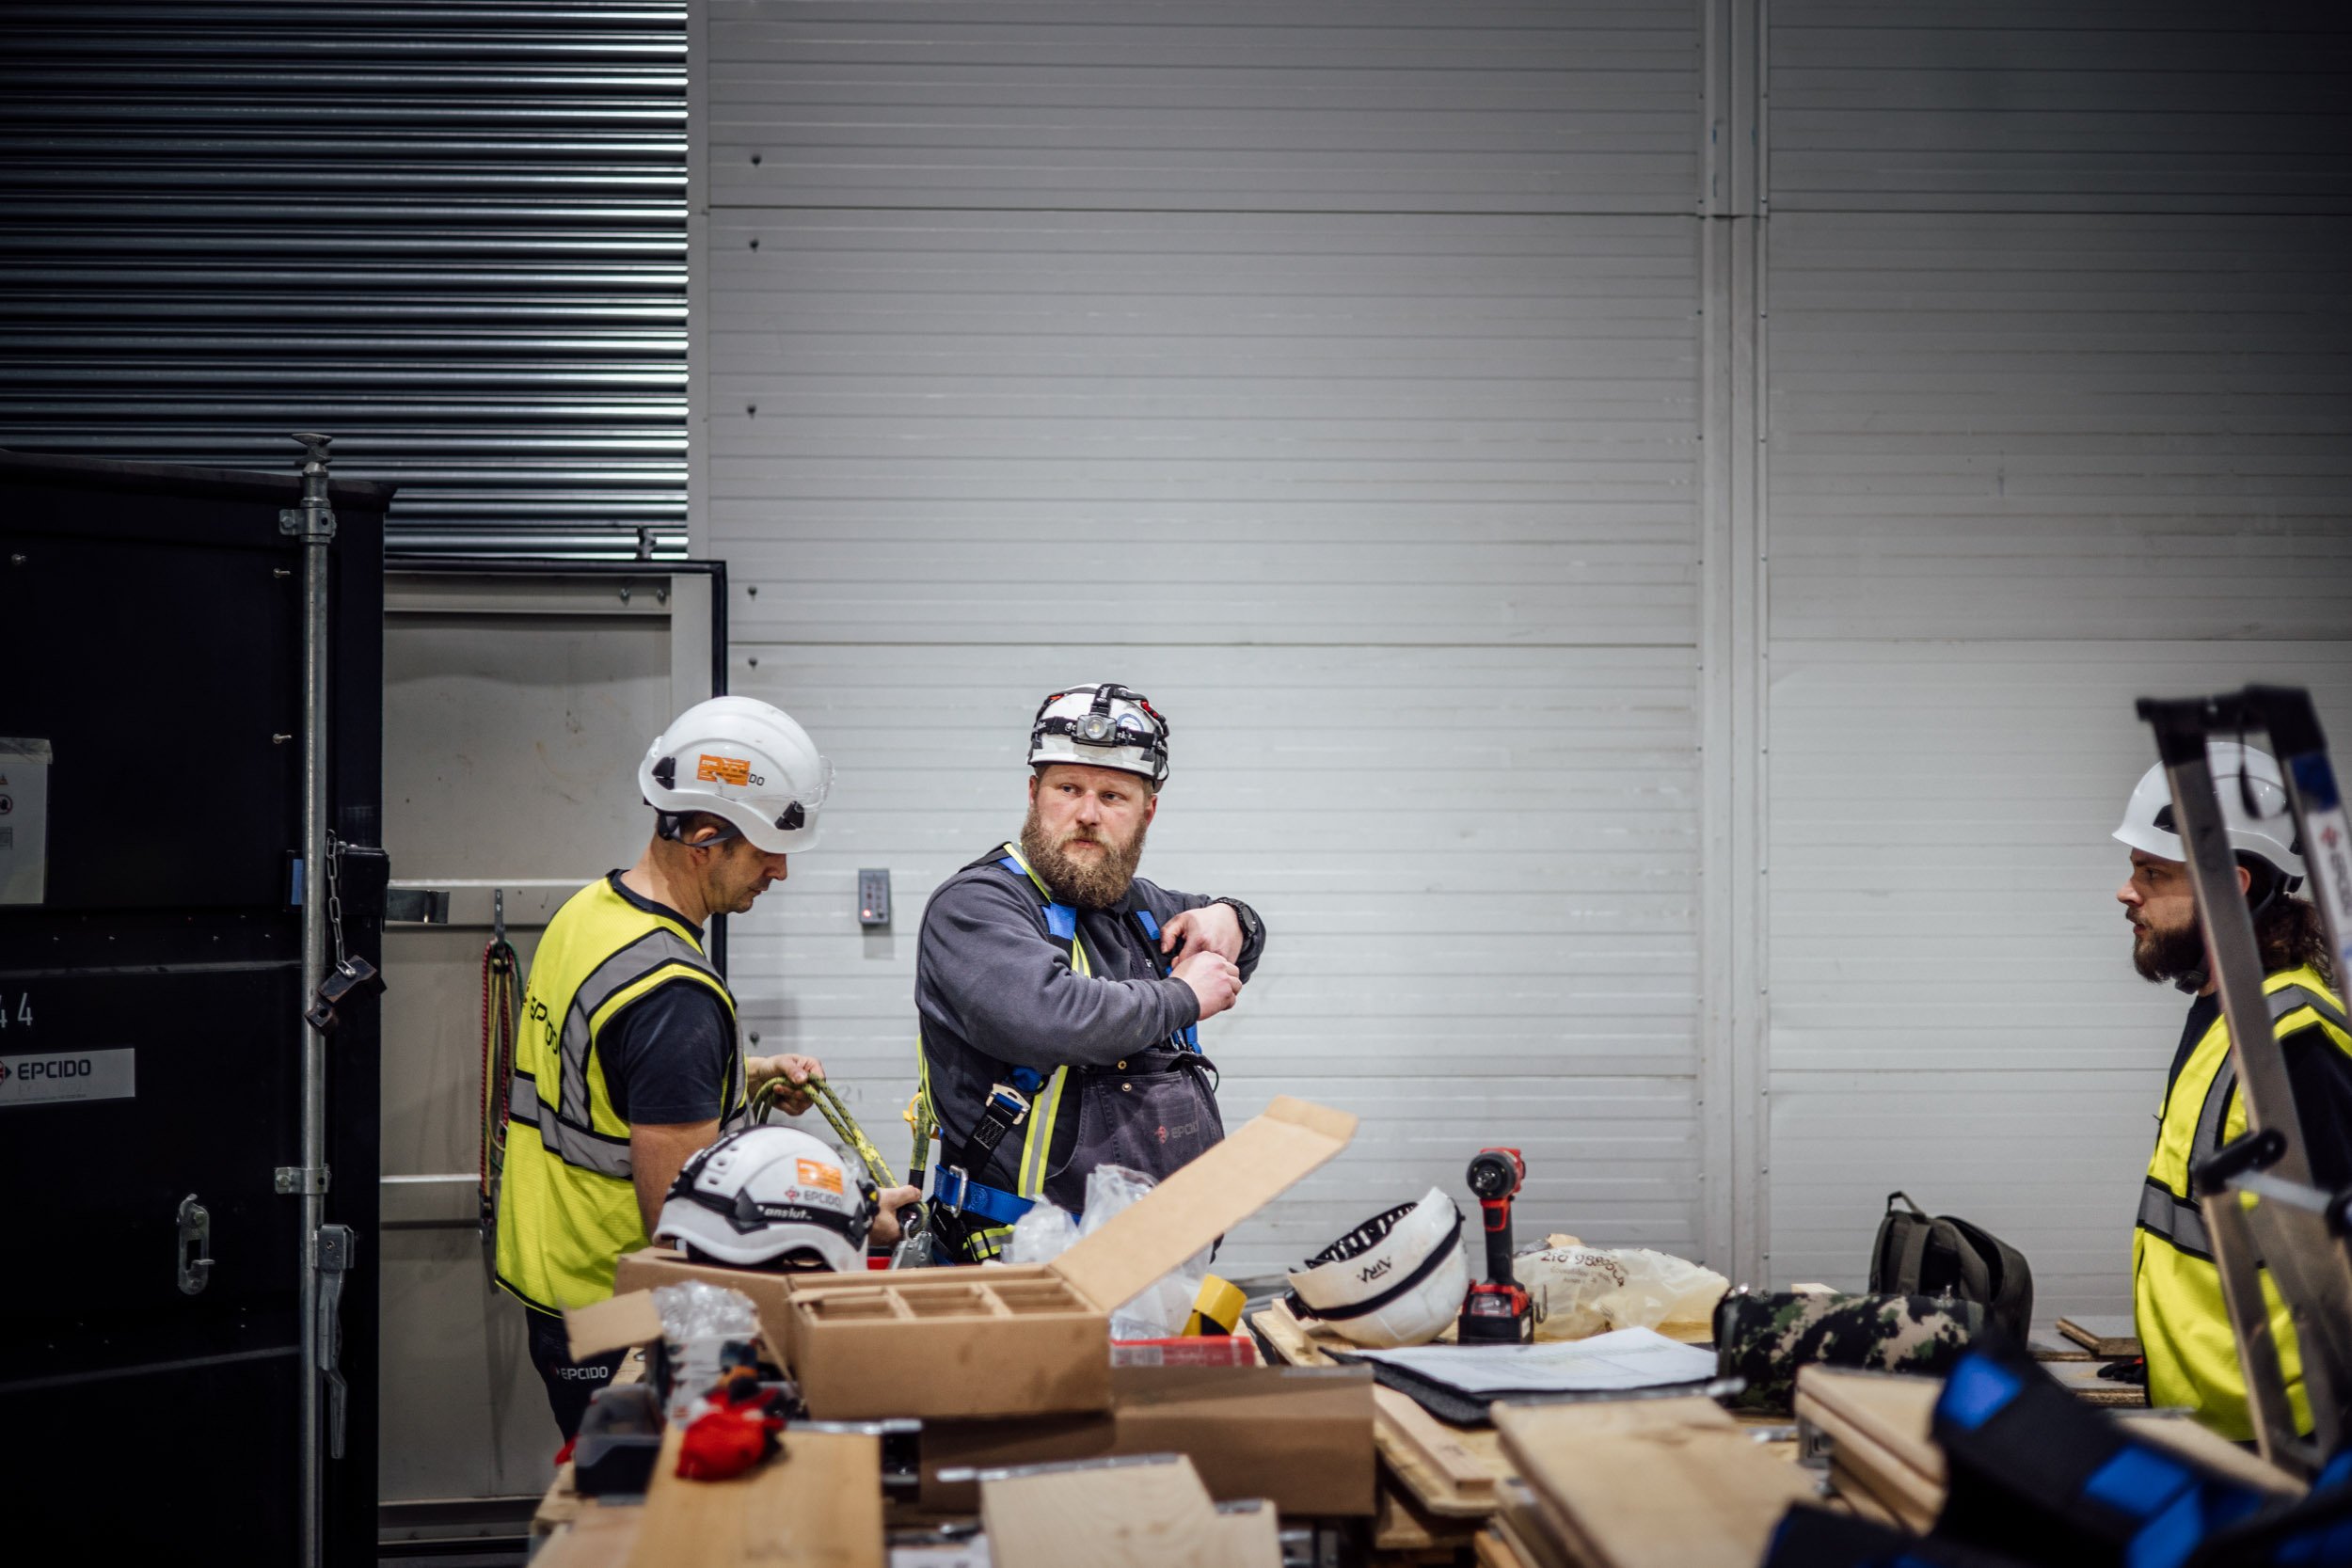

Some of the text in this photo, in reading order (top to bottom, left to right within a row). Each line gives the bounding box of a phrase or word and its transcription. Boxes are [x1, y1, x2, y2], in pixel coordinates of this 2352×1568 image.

[18, 1059, 91, 1081] EPCIDO
[803, 1190, 842, 1206] EPCIDO
[561, 1366, 609, 1380] EPCIDO
